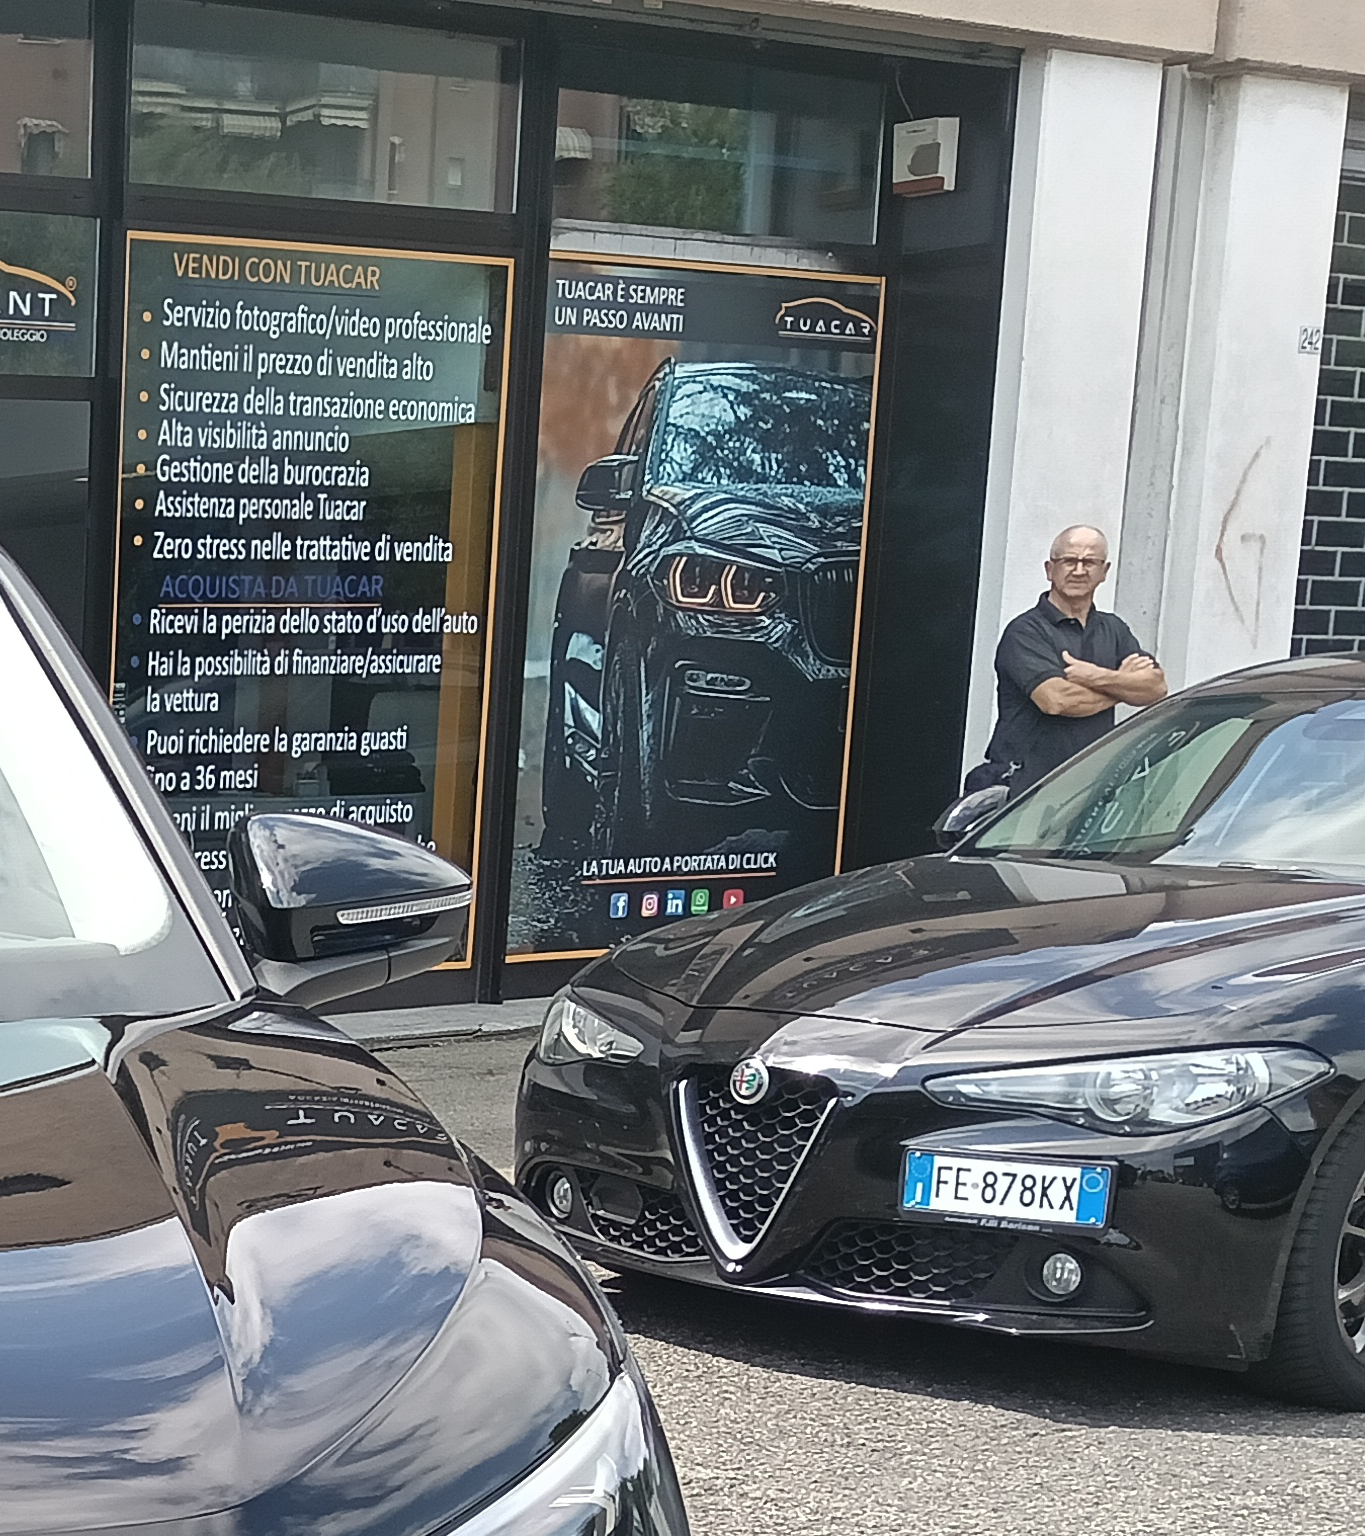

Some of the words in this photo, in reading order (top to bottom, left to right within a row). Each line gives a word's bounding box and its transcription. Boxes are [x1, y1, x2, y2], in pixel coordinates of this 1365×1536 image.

[173, 252, 239, 281] VENDI
[245, 257, 291, 284] CON
[297, 261, 381, 290] TUACAR
[555, 279, 614, 301] TUACAR
[617, 279, 626, 303] È
[629, 284, 686, 307] SEMPRE
[162, 298, 231, 330] Servizio
[235, 300, 380, 340] fotografico/video
[384, 311, 492, 344] professionale
[554, 306, 578, 326] UN
[582, 307, 628, 329] PASSO
[631, 311, 684, 333] AVANTI
[784, 316, 871, 336] TUACAR
[1301, 327, 1321, 350] 242
[160, 340, 239, 372] Mantieni
[243, 343, 254, 373] il
[257, 350, 313, 380] prezzo
[316, 347, 333, 376] di
[336, 350, 398, 379] vendita
[402, 352, 434, 381] alto
[159, 383, 239, 414] Sicurezza
[243, 385, 284, 416] della
[289, 391, 385, 419] transazione
[388, 396, 476, 423] economica
[157, 417, 193, 448] Alta
[272, 425, 350, 453] annuncio
[156, 454, 234, 483] Gestione
[238, 455, 279, 485] della
[283, 456, 370, 487] burocrazia
[155, 489, 235, 519] Assistenza
[239, 491, 314, 526] personale
[317, 493, 367, 521] Tuacar
[152, 531, 193, 560] Zero
[196, 534, 246, 560] stress
[250, 531, 292, 560] nelle
[296, 534, 371, 561] trattative
[374, 533, 391, 562] di
[393, 534, 453, 562] vendita
[159, 574, 266, 603] ACQUISTA
[271, 575, 298, 599] DA
[304, 575, 384, 599] TUACAR
[149, 608, 199, 634] Ricevi
[202, 607, 217, 634] la
[221, 608, 275, 641] perizia
[279, 607, 319, 634] dello
[322, 610, 363, 634] stato
[147, 650, 174, 677] Hai
[177, 649, 191, 676] la
[194, 648, 271, 682] possibilità
[274, 648, 289, 675] di
[292, 647, 442, 678] finanziare/assicurare
[146, 685, 160, 713] la
[164, 688, 219, 712] vettura
[146, 728, 184, 755] Puoi
[188, 726, 270, 754] richiedere
[274, 725, 288, 753] la
[291, 726, 357, 758] garanzia
[360, 725, 408, 757] guasti
[180, 771, 191, 791] a
[194, 765, 216, 790] 36
[219, 763, 259, 789] mesi
[200, 804, 210, 831] il
[348, 799, 413, 826] acquisto
[582, 859, 599, 876] LA
[600, 858, 626, 875] TUA
[626, 856, 661, 874] AUTO
[662, 856, 672, 872] A
[673, 854, 726, 872] PORTATA
[728, 853, 741, 870] DI
[742, 852, 777, 869] CLICK
[980, 1171, 1078, 1211] 878KX
